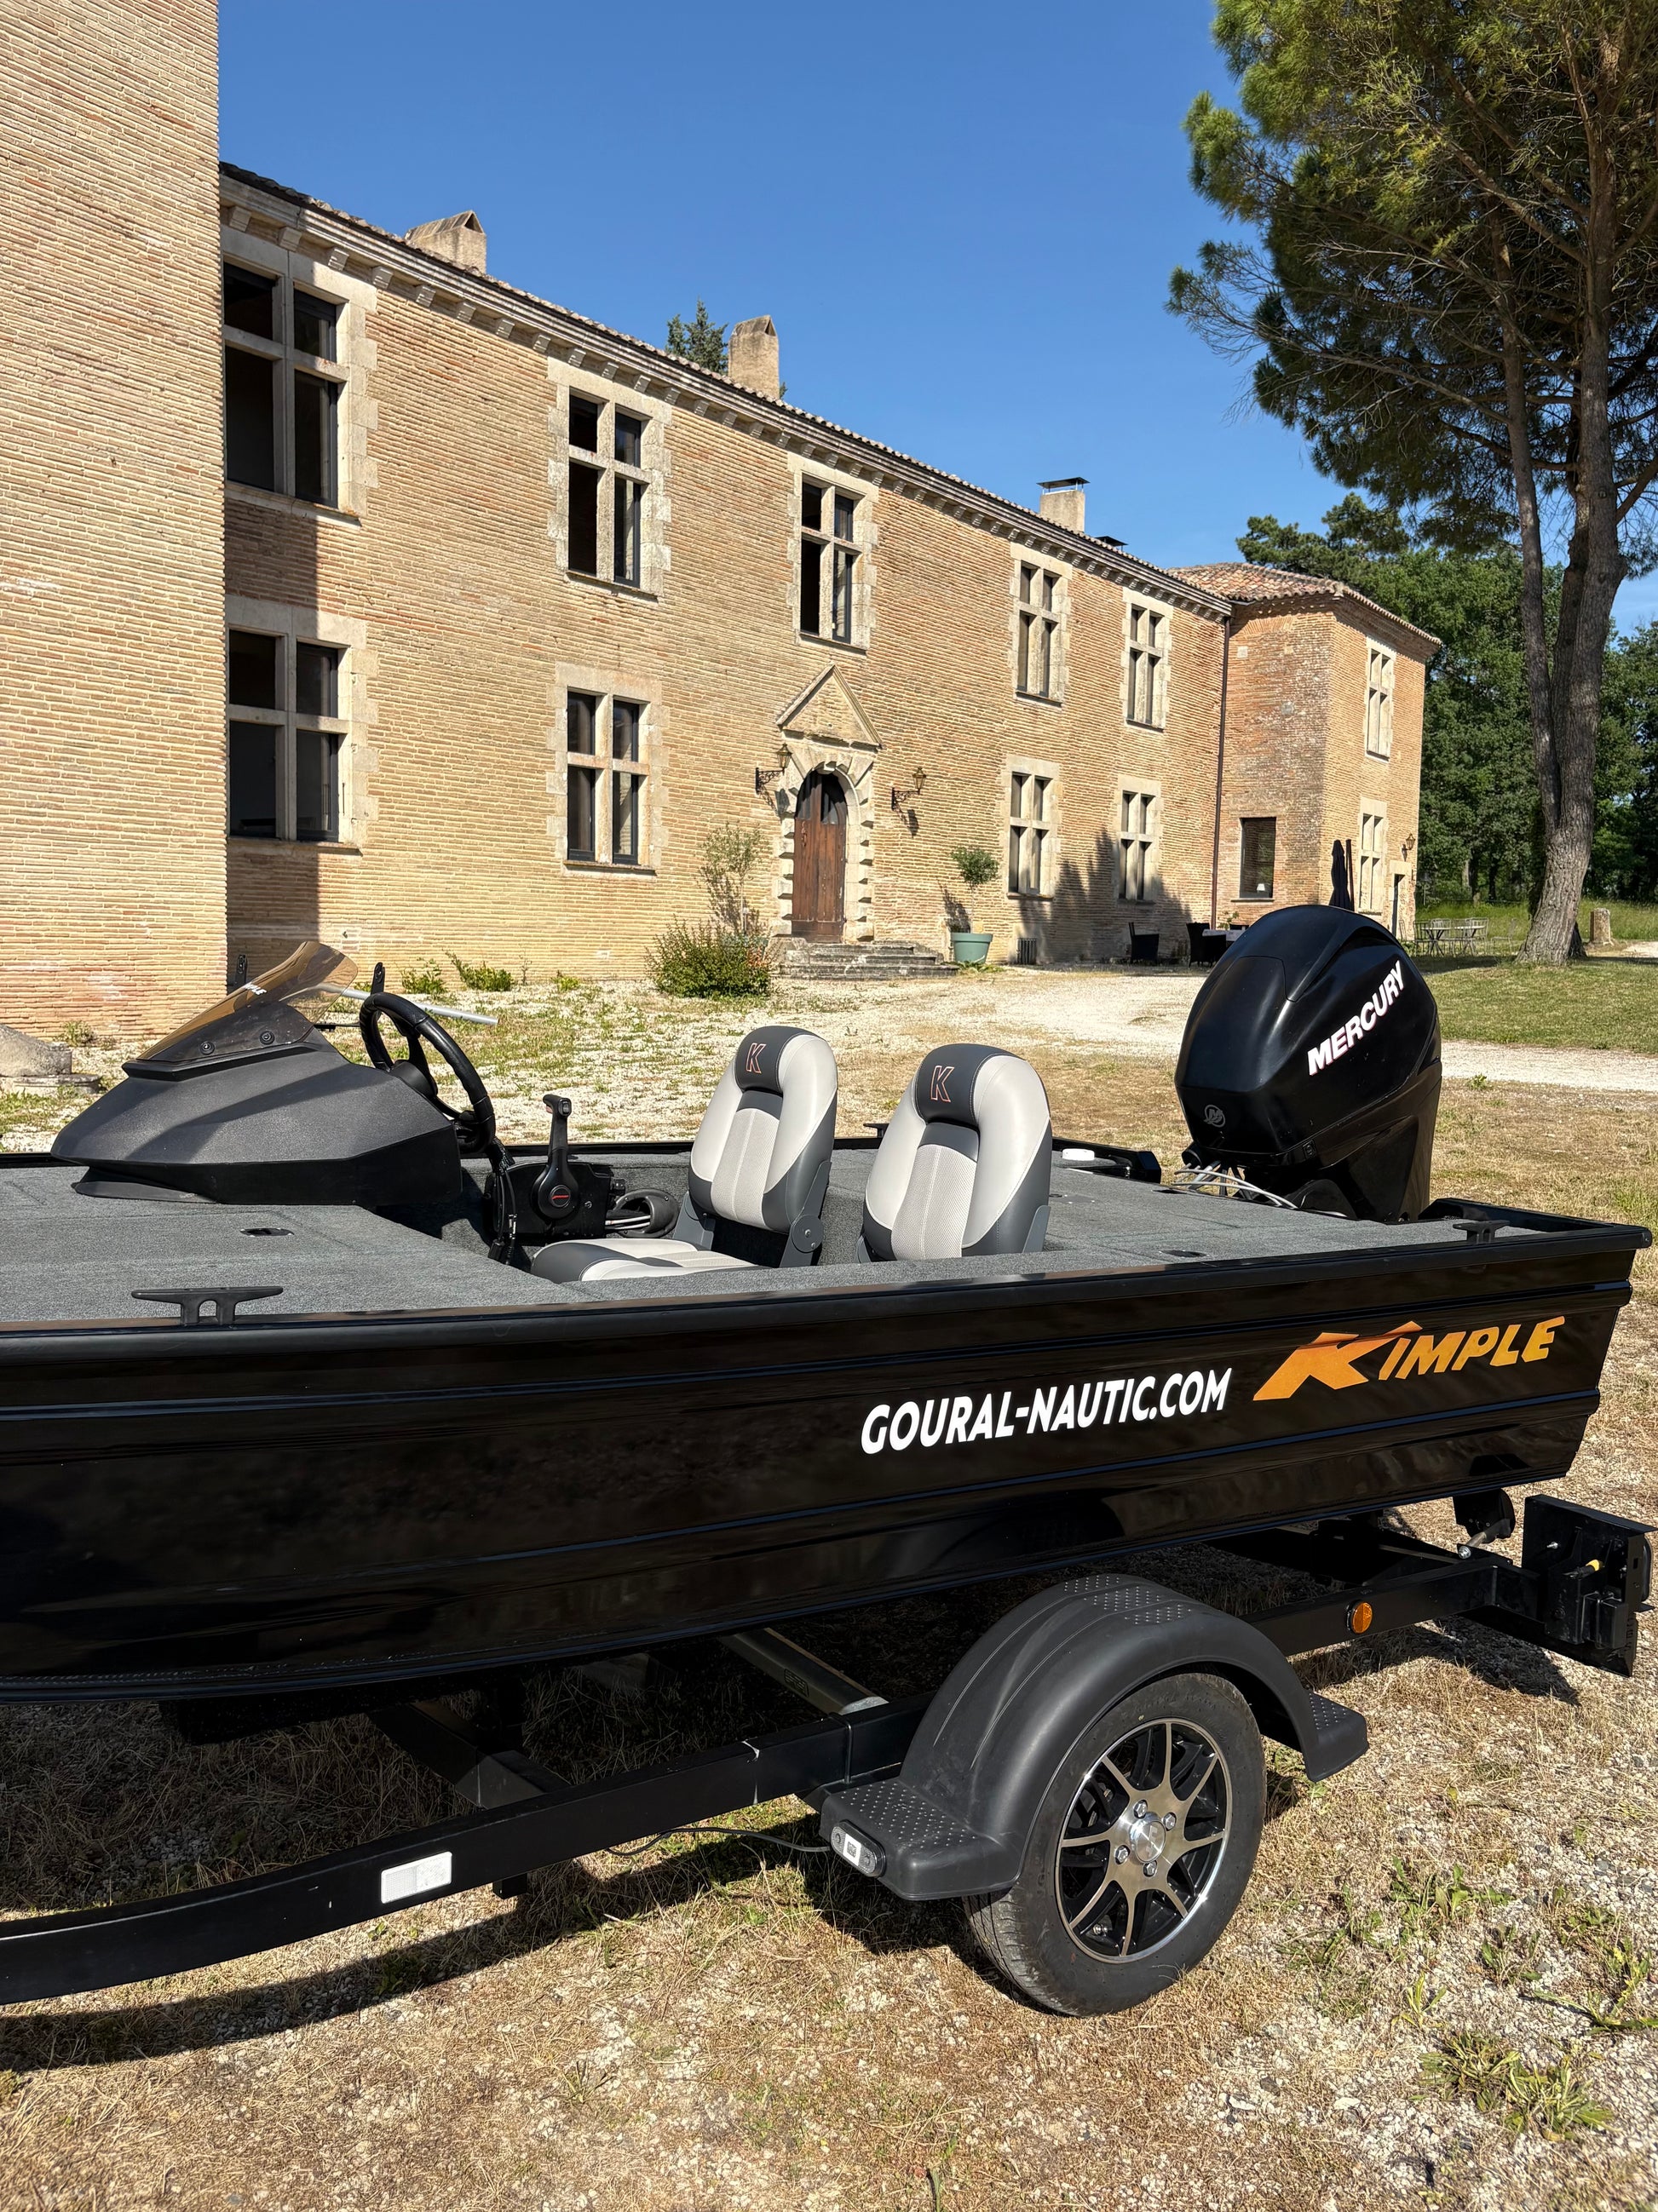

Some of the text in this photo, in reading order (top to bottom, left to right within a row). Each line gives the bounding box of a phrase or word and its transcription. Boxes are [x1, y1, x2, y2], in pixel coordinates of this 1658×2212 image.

[746, 1043, 766, 1073] K
[1307, 960, 1405, 1075] MERCURY
[930, 1065, 955, 1102] K
[1253, 1316, 1565, 1401] KIMPLE
[861, 1368, 1233, 1455] GOURAL-NAUTIC.COM
